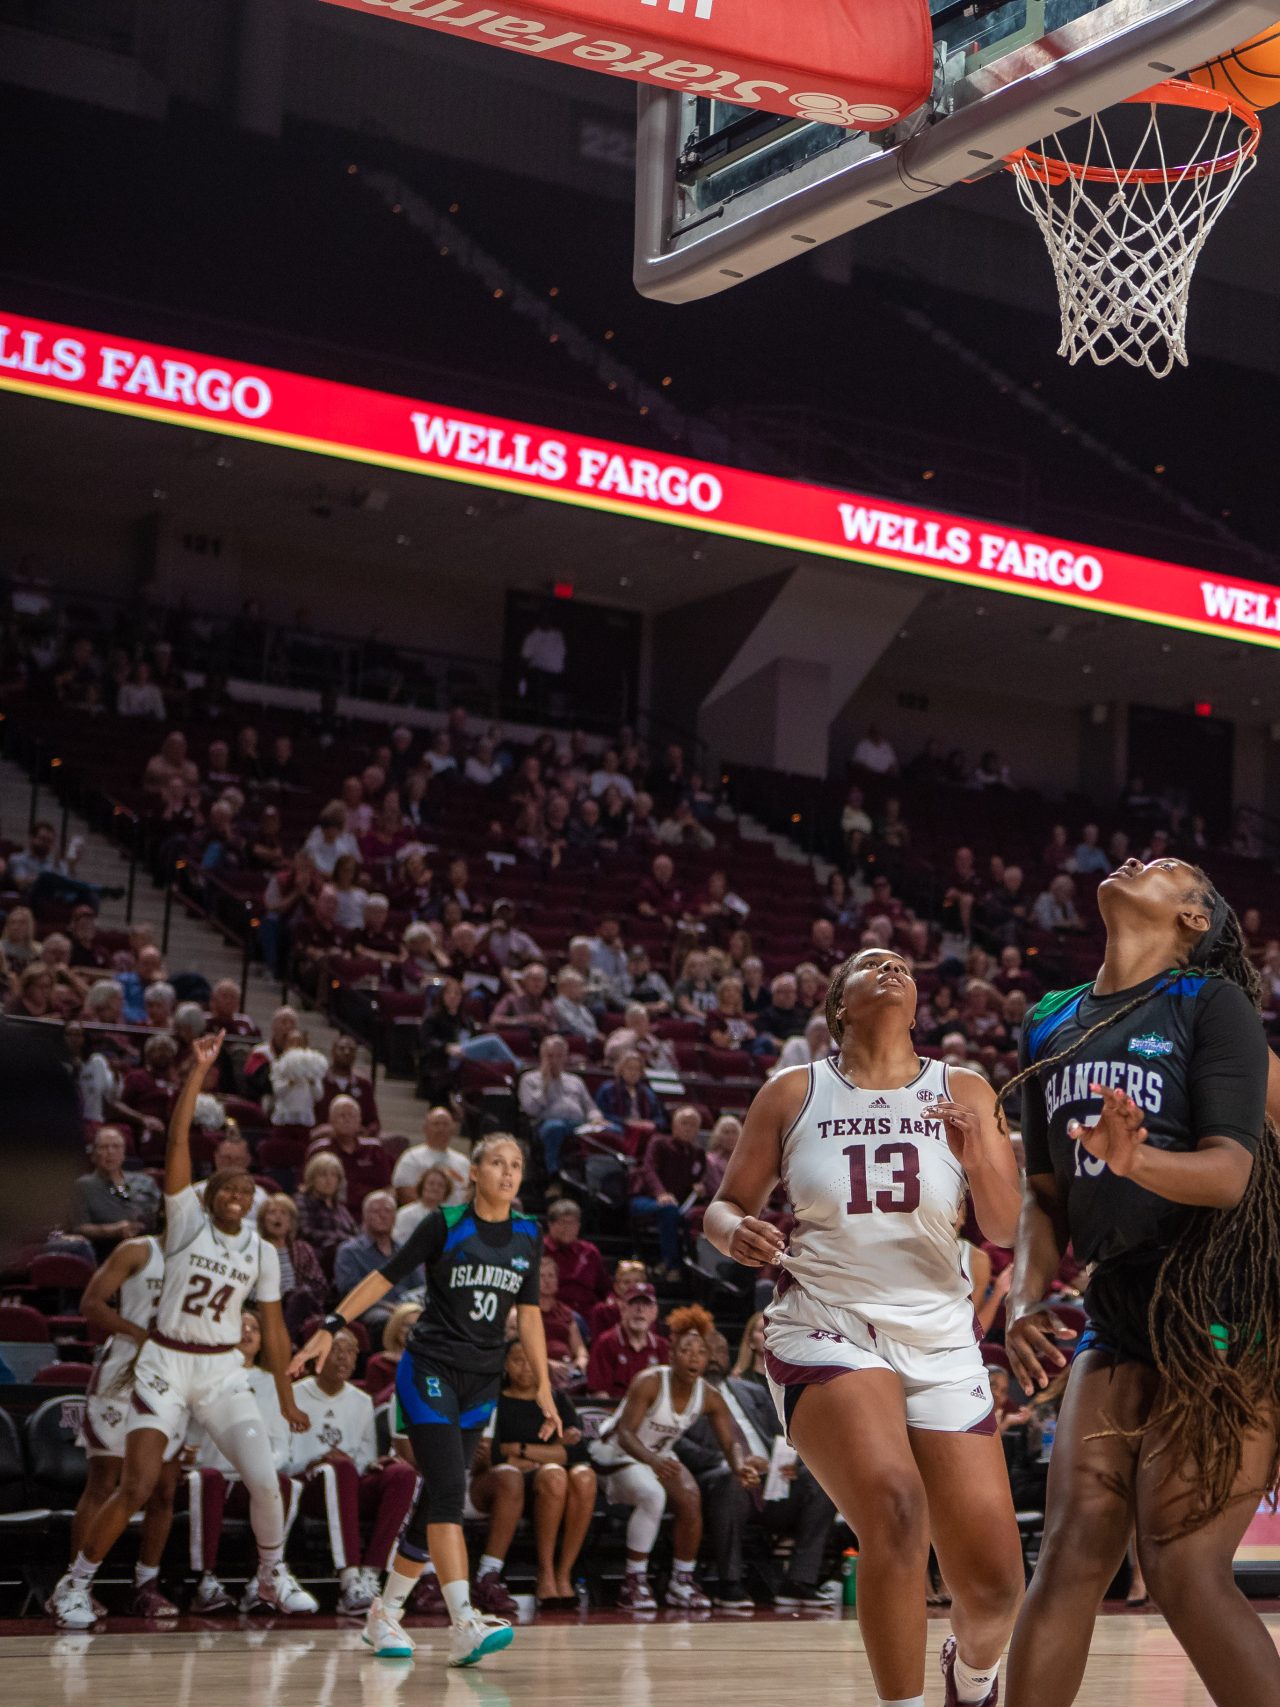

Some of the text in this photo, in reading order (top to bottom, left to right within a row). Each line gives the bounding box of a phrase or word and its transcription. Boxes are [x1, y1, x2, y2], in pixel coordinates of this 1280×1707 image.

[0, 325, 273, 419] LLS FARGO
[410, 412, 722, 512] WELLS FARGO
[837, 502, 1103, 592] WELLS FARGO
[817, 1117, 941, 1140] TEXAS A&M
[842, 1142, 921, 1215] 13
[189, 1254, 227, 1276] TEXAS
[449, 1263, 523, 1294] ISLANDERS
[182, 1274, 235, 1323] 24
[468, 1290, 498, 1322] 30
